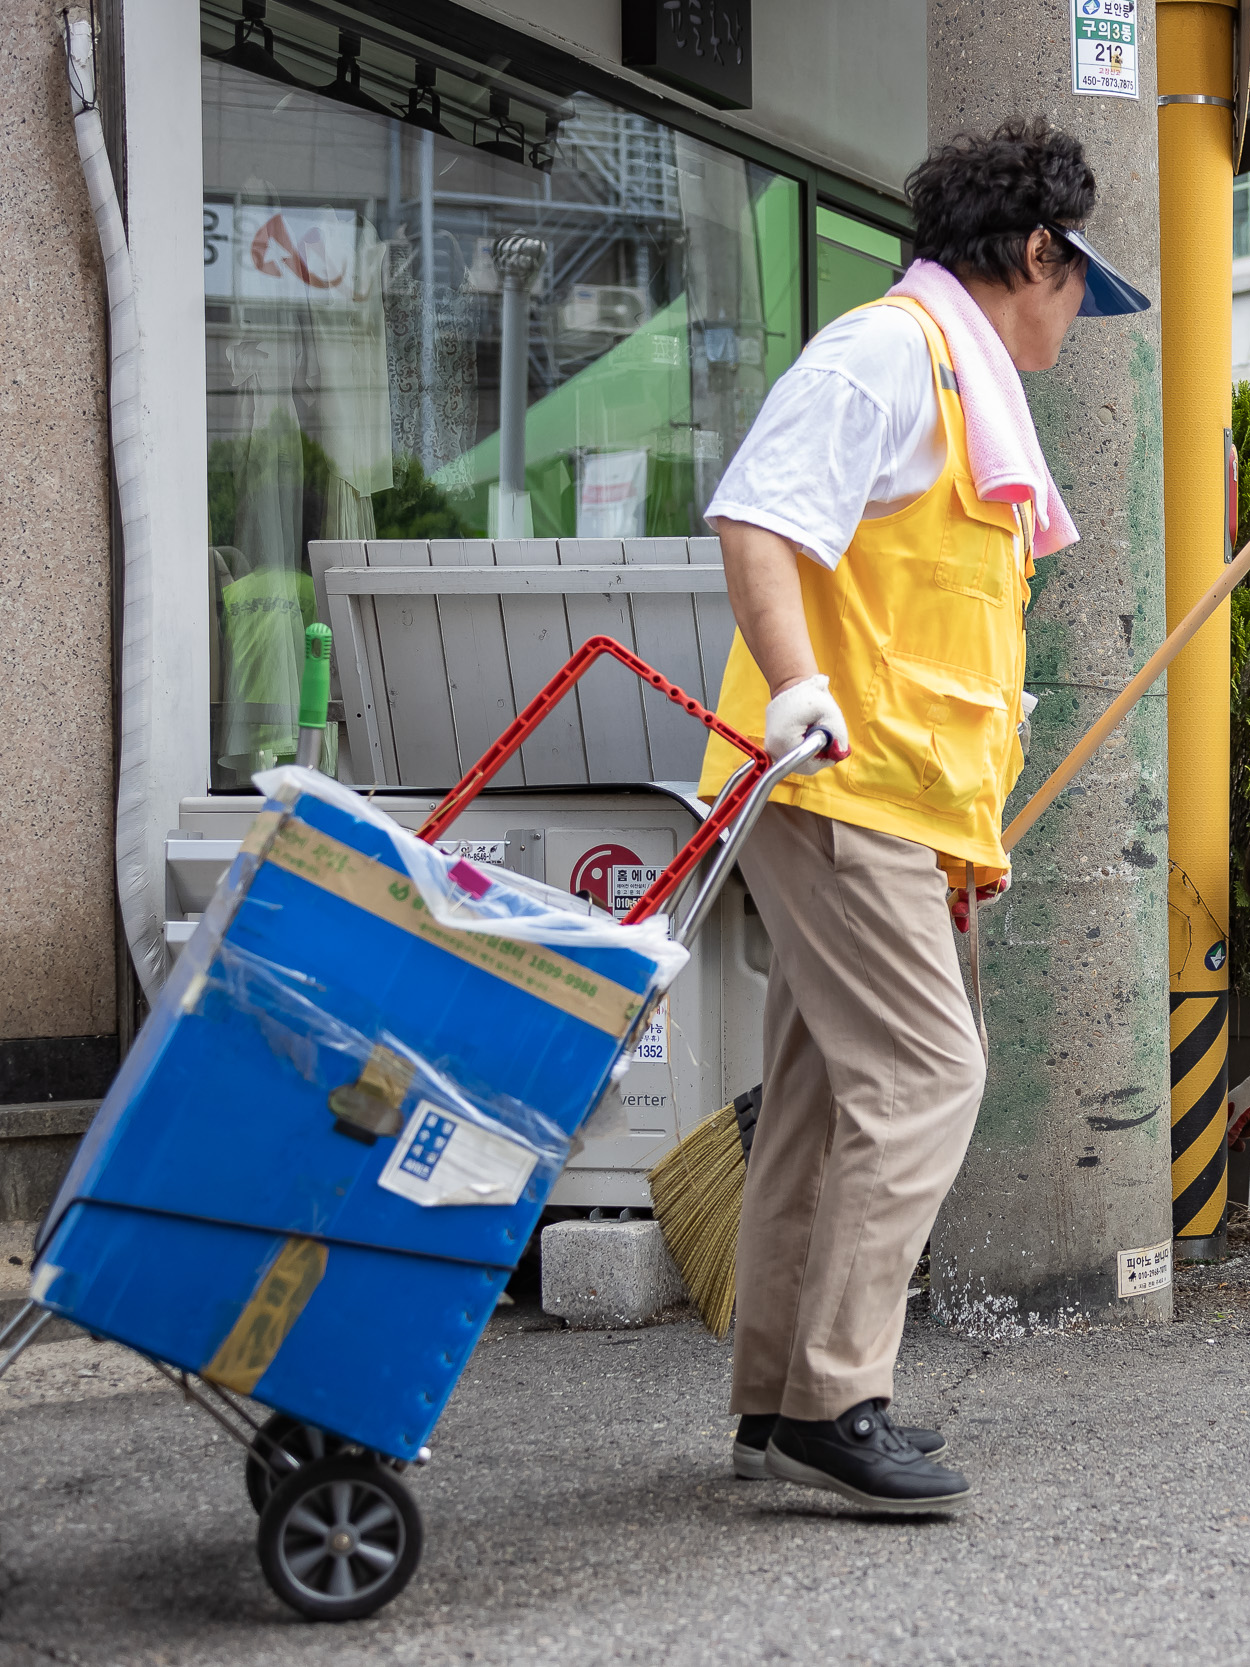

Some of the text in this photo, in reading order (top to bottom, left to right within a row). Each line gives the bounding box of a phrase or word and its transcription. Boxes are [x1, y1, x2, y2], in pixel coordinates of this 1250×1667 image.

[1104, 2, 1132, 18] 보안등
[1082, 20, 1132, 42] 구의3동
[1126, 1248, 1169, 1269] 피아노 삽니다
